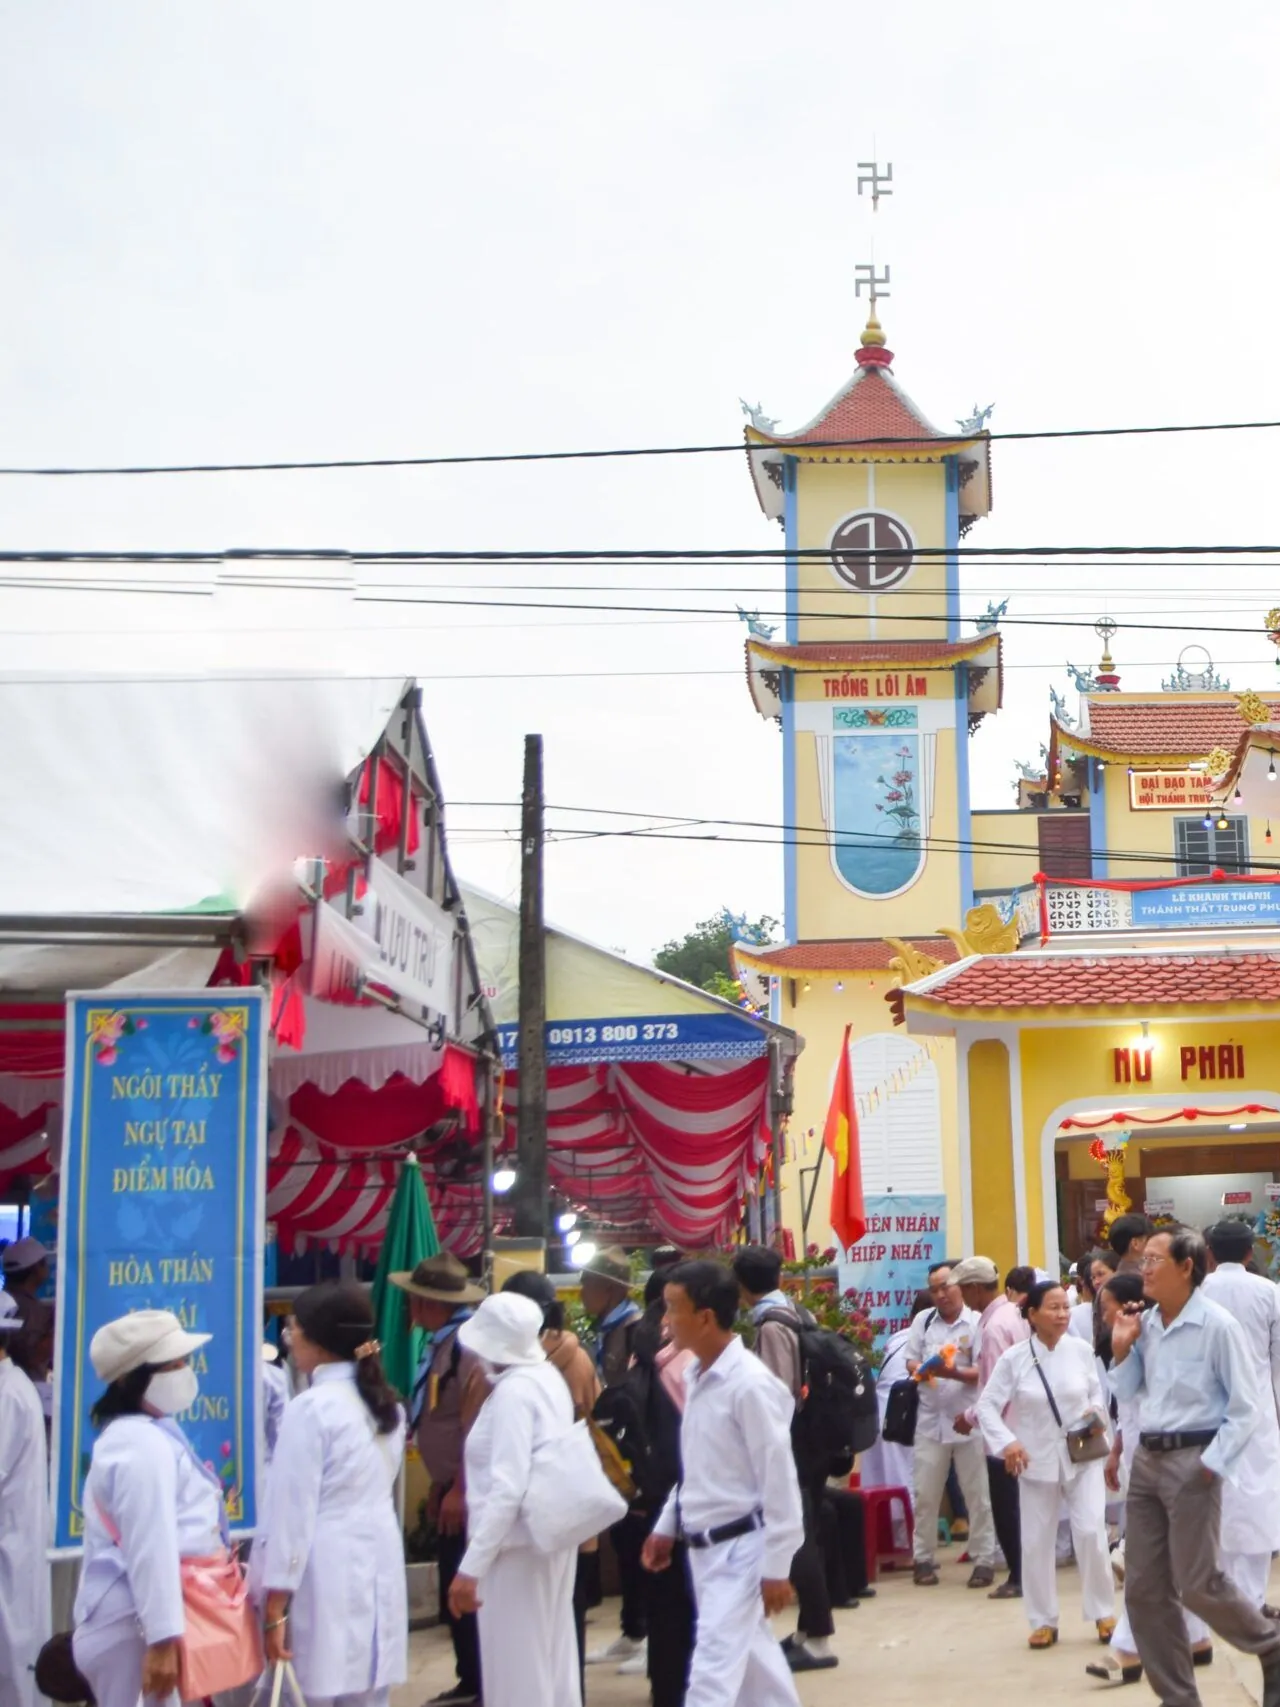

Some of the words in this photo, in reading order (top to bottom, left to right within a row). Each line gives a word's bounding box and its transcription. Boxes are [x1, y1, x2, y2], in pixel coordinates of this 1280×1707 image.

[876, 674, 899, 697] LÔI
[1217, 903, 1256, 913] TRUNG
[549, 1026, 597, 1044] 0913
[602, 1025, 638, 1041] 800
[642, 1023, 679, 1039] 373
[1180, 1038, 1245, 1081] PHÁI
[172, 1120, 207, 1150] TẠI
[864, 1213, 892, 1233] IÊN
[895, 1212, 940, 1233] NHÂN
[891, 1237, 933, 1260] NHẤT
[859, 1286, 890, 1308] ÂM
